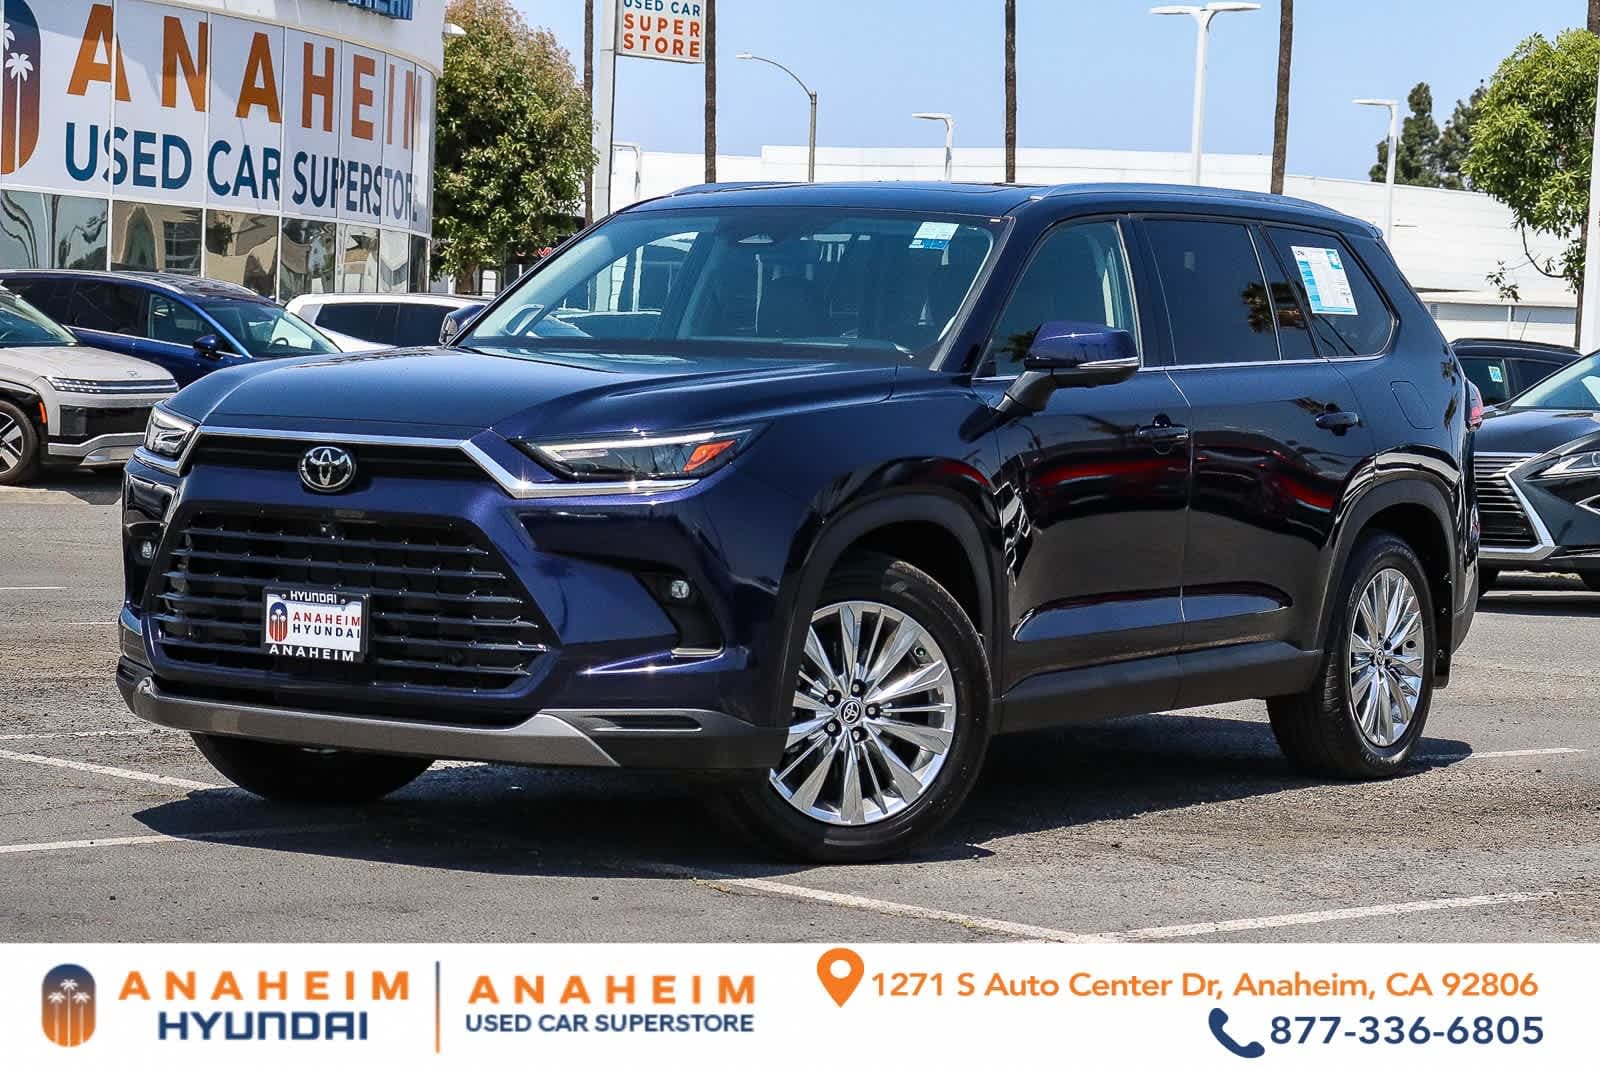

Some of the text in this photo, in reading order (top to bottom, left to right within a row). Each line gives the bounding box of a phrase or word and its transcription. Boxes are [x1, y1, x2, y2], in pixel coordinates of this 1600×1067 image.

[623, 0, 700, 16] USED CAR
[623, 13, 700, 37] SUPER
[623, 33, 700, 57] STORE
[65, 121, 192, 190] USED
[207, 139, 281, 201] CAR
[290, 590, 337, 604] HYUNDAI
[293, 612, 360, 626] ANAHEIM
[293, 624, 360, 639] HYUNDAI
[269, 644, 355, 662] ANAHEIM
